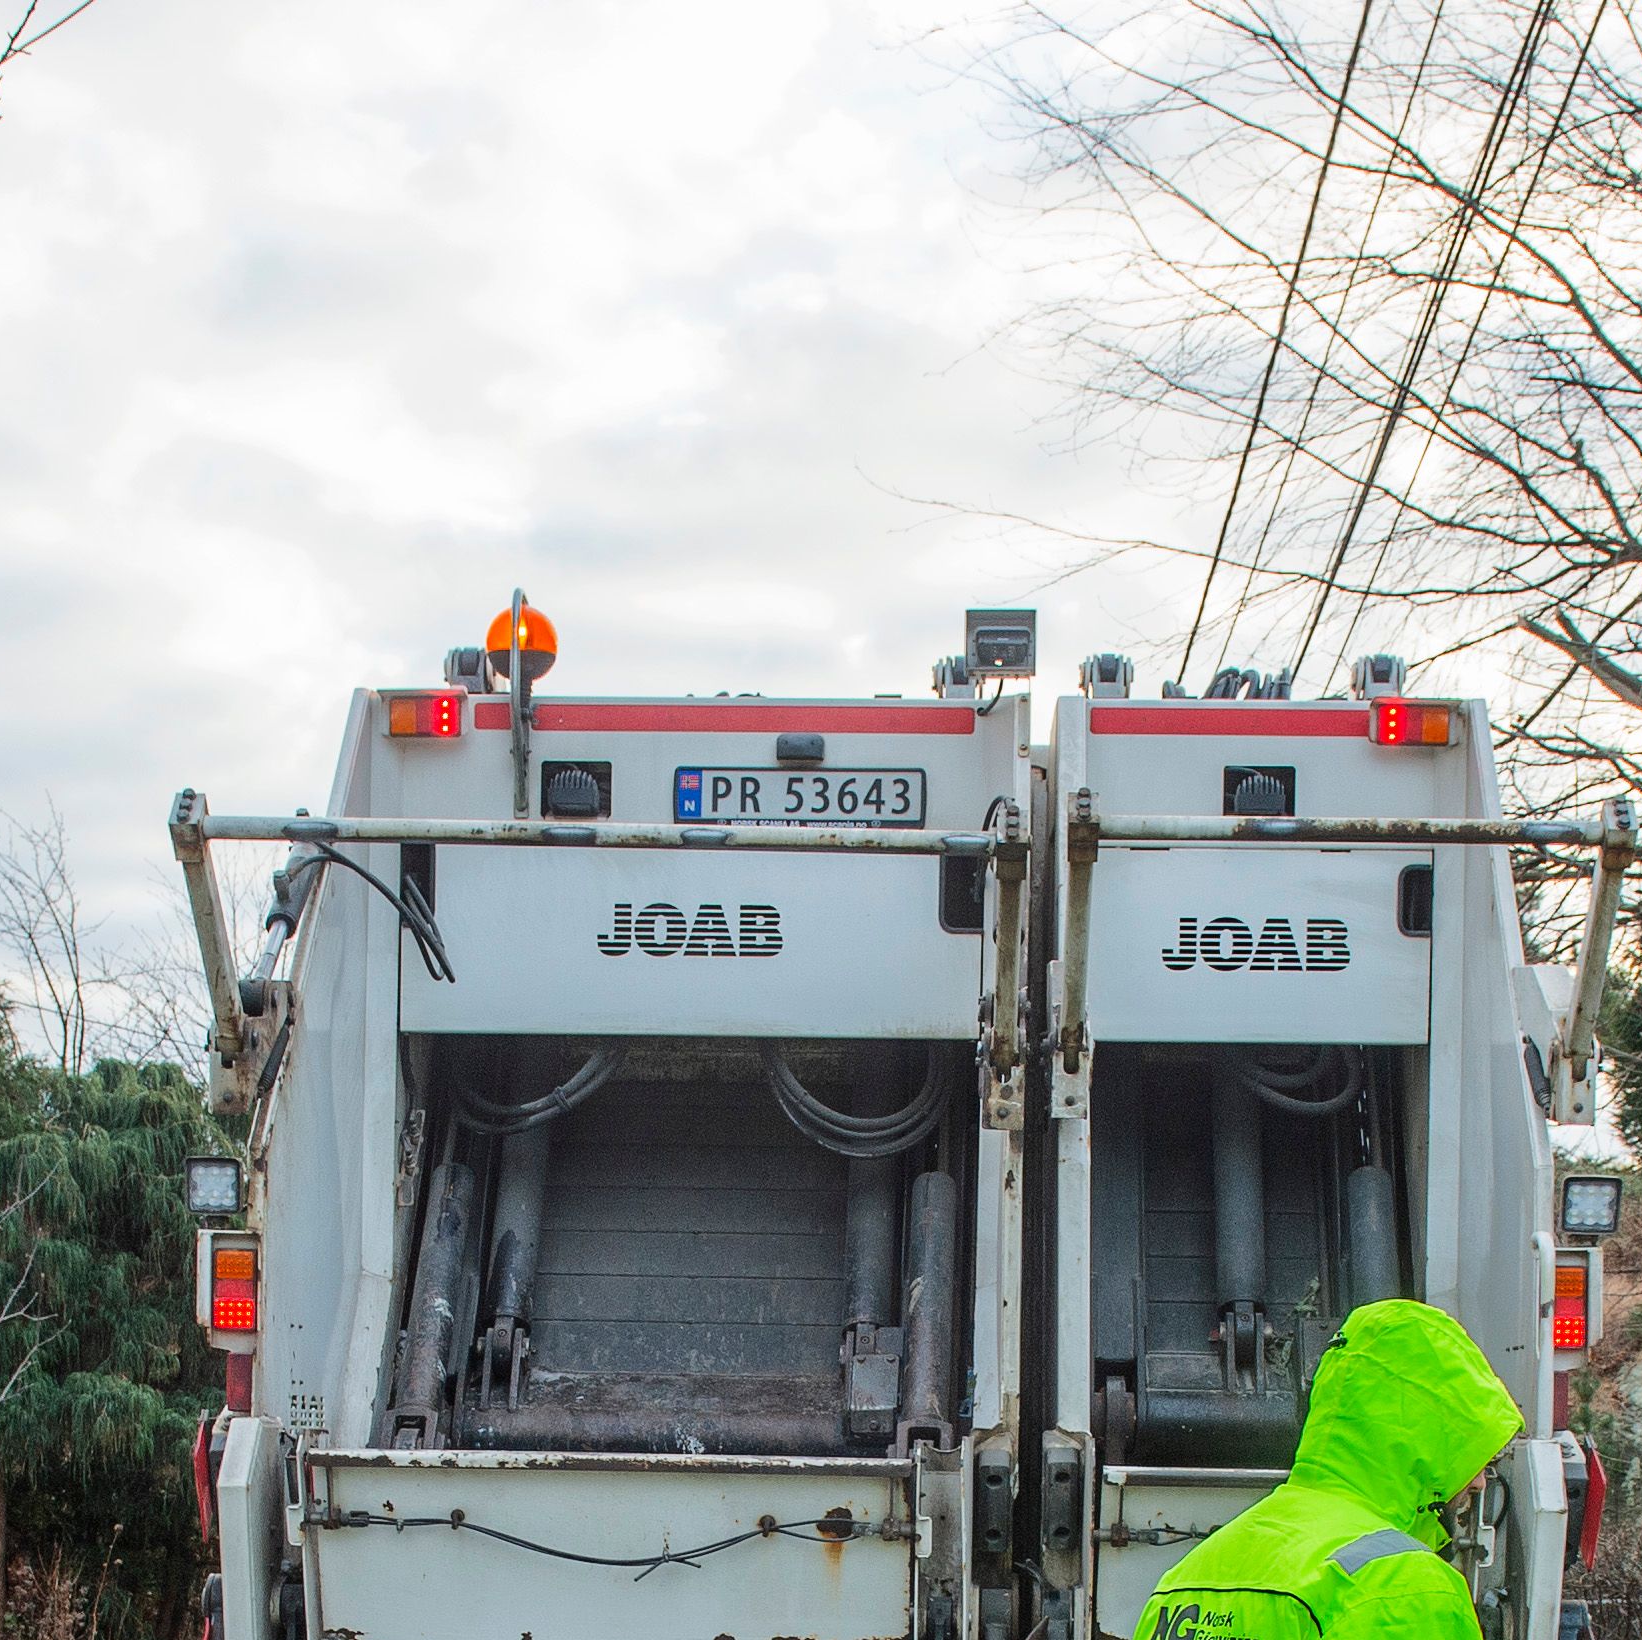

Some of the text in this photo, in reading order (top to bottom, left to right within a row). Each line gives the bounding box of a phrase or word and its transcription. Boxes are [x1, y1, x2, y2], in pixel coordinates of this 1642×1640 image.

[684, 799, 695, 811] N
[711, 776, 911, 815] PR 53643
[596, 902, 784, 958] JOAB
[1161, 916, 1351, 972] JOAB
[1201, 1610, 1235, 1628] Nosk
